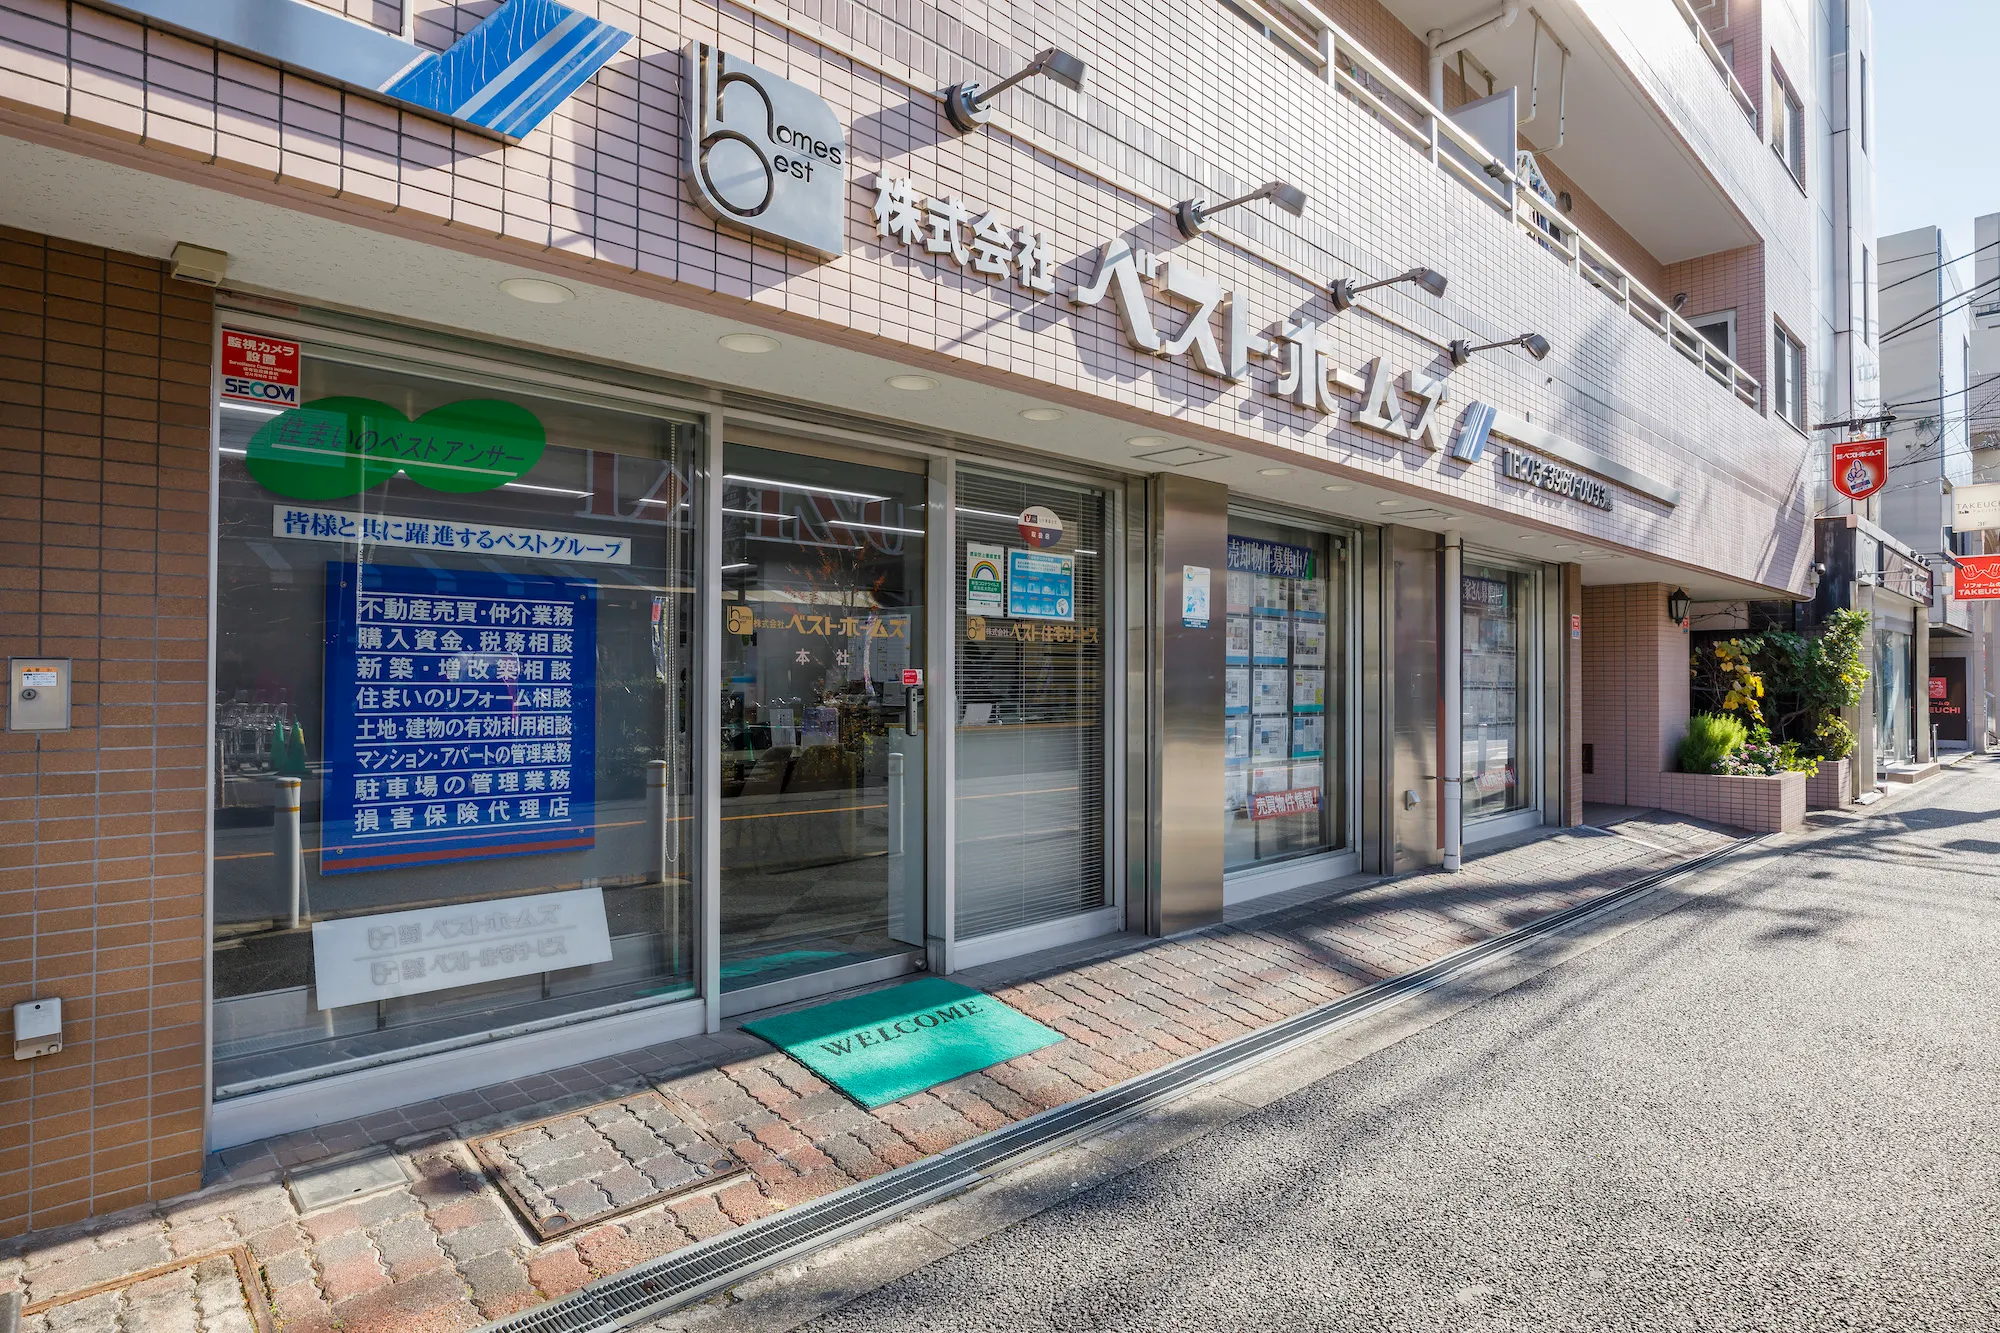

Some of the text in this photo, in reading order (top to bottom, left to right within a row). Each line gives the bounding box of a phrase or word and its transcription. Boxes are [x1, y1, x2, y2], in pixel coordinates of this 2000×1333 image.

[871, 169, 1055, 295] 株式会社
[227, 335, 295, 356] 監視カメラ
[246, 350, 276, 366] 設置
[225, 378, 295, 402] SECOM
[279, 415, 525, 468] 住まいのベストアンサー
[1956, 500, 2000, 510] TAKEUC
[284, 511, 623, 559] 皆様と共に躍進するベストグループ
[360, 598, 574, 626] 不動産売買・仲介業務
[754, 618, 785, 630] 株式会社
[357, 628, 573, 653] 購入資金、税務相談
[357, 656, 572, 681] 新築・増改築相談
[356, 687, 572, 709] 住まいのリフォーム相談
[356, 716, 572, 740] 土地・建物の有効利用相談
[355, 743, 571, 770] マンション・アパートの管理業務
[354, 769, 571, 802] 駐車場の管理業務
[354, 797, 570, 832] 損害保険代理店
[820, 1000, 984, 1057] WELCOME
